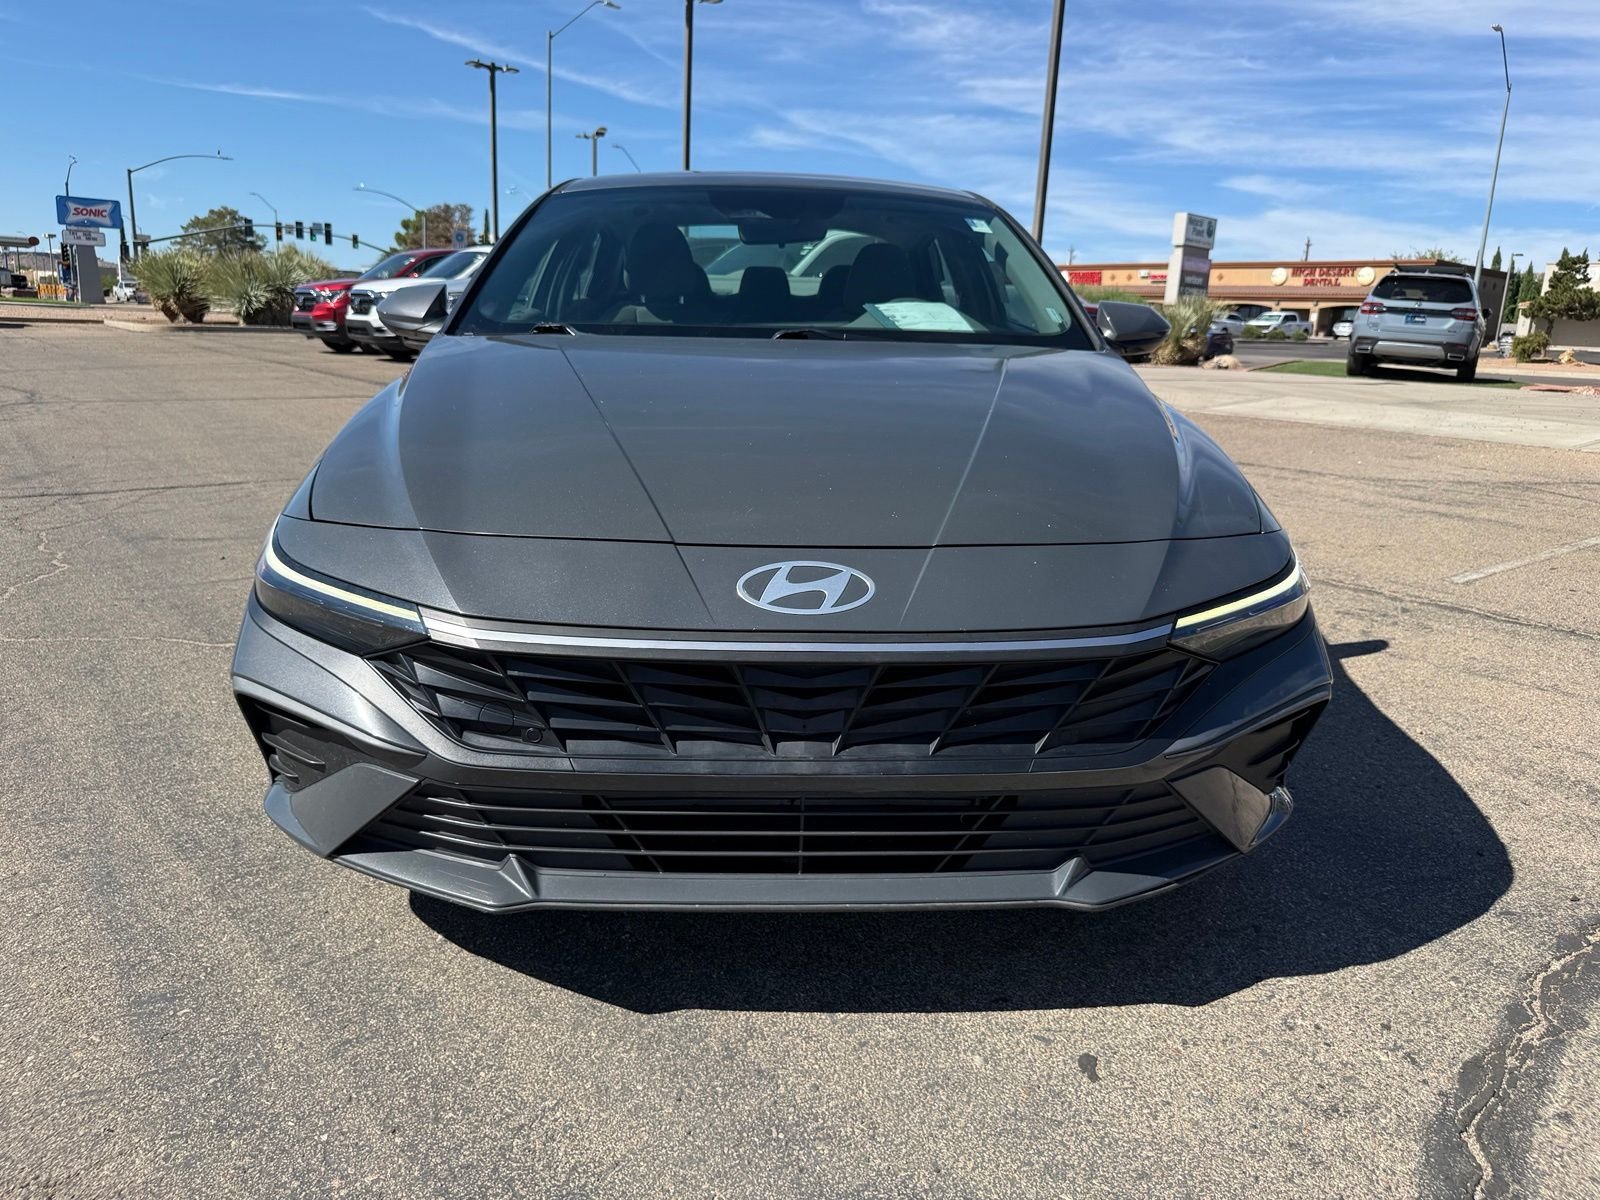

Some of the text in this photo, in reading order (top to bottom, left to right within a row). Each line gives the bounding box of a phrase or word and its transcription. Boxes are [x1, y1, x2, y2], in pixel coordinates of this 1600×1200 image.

[72, 207, 107, 218] SONIC
[1291, 267, 1356, 277] HIGH DESERT
[1303, 278, 1341, 287] DENTAL
